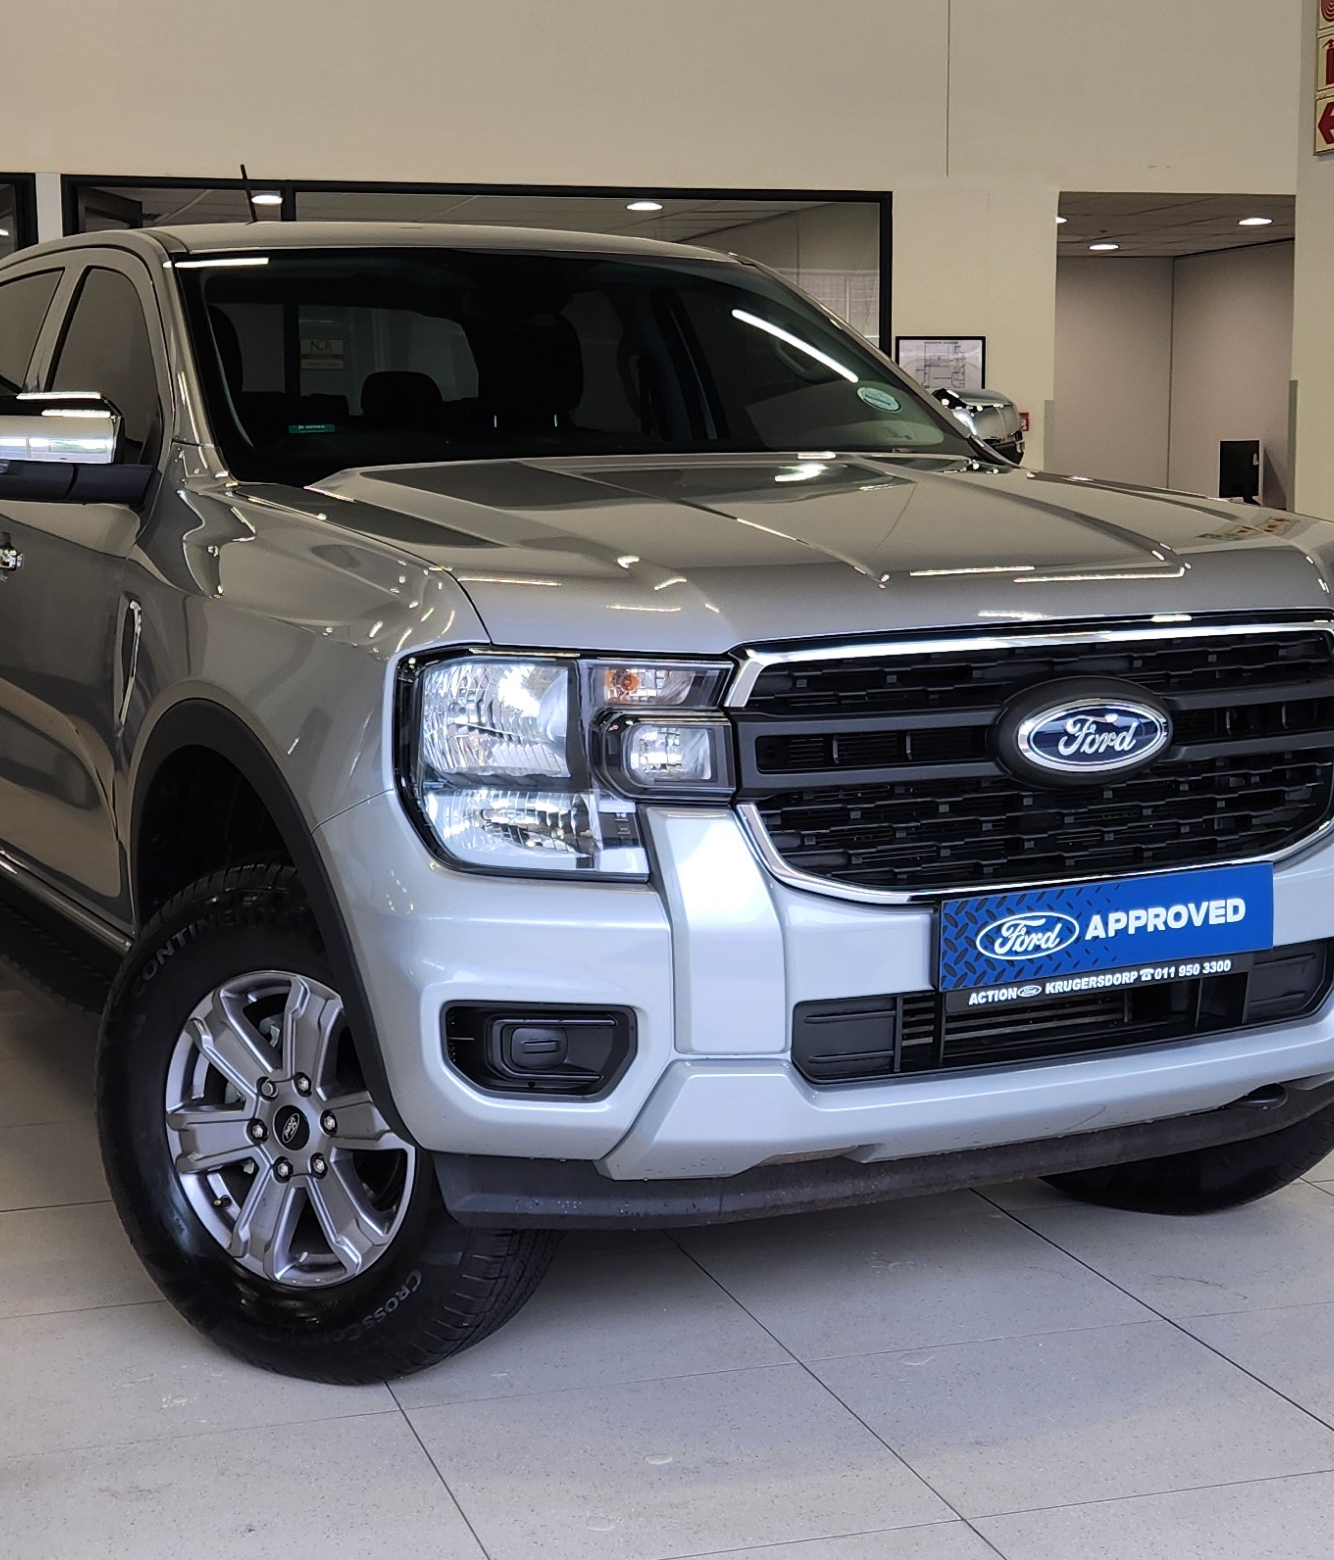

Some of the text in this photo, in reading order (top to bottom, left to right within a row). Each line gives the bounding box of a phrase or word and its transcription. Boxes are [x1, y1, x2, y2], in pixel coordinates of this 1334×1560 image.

[1058, 714, 1139, 756] Ford
[994, 897, 1246, 955] Ford APPROVED
[968, 987, 1018, 1006] ACTION
[1045, 971, 1139, 995] KRUGERSDORP
[1154, 965, 1176, 980] 011
[1178, 962, 1201, 977] 950
[1202, 959, 1232, 974] 3300
